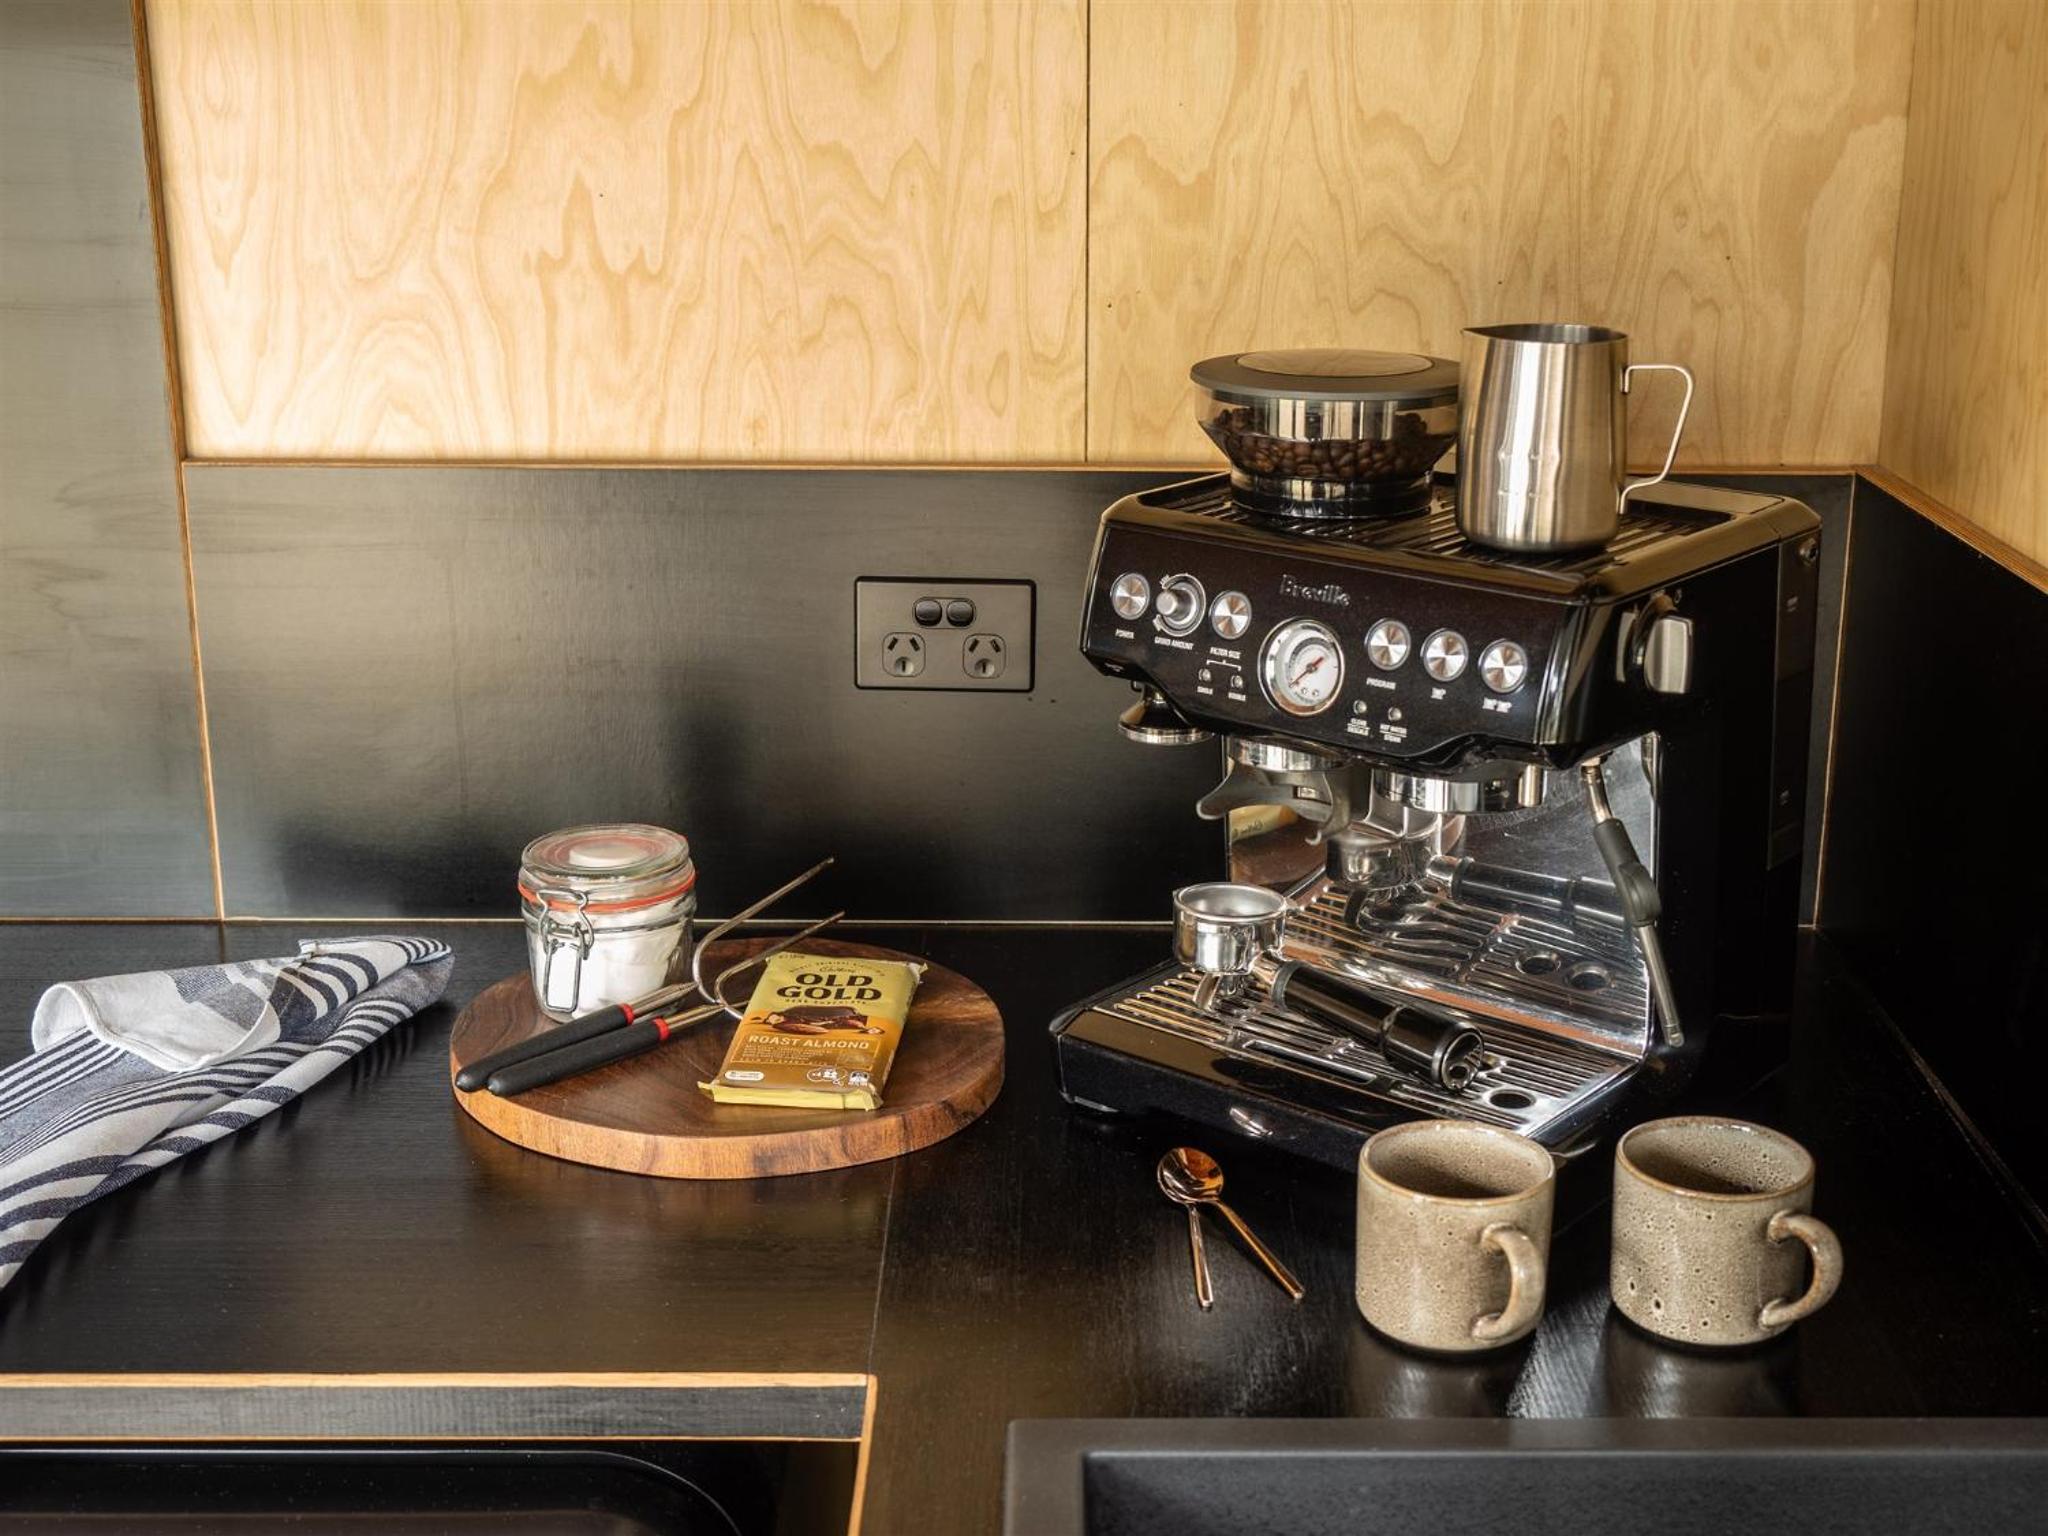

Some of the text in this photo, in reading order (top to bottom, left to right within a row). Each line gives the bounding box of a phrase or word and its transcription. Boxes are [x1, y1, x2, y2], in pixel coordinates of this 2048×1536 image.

[795, 973, 873, 987] OLD
[777, 986, 882, 1000] GOLD
[748, 1035, 869, 1049] ROAST ALMOND
